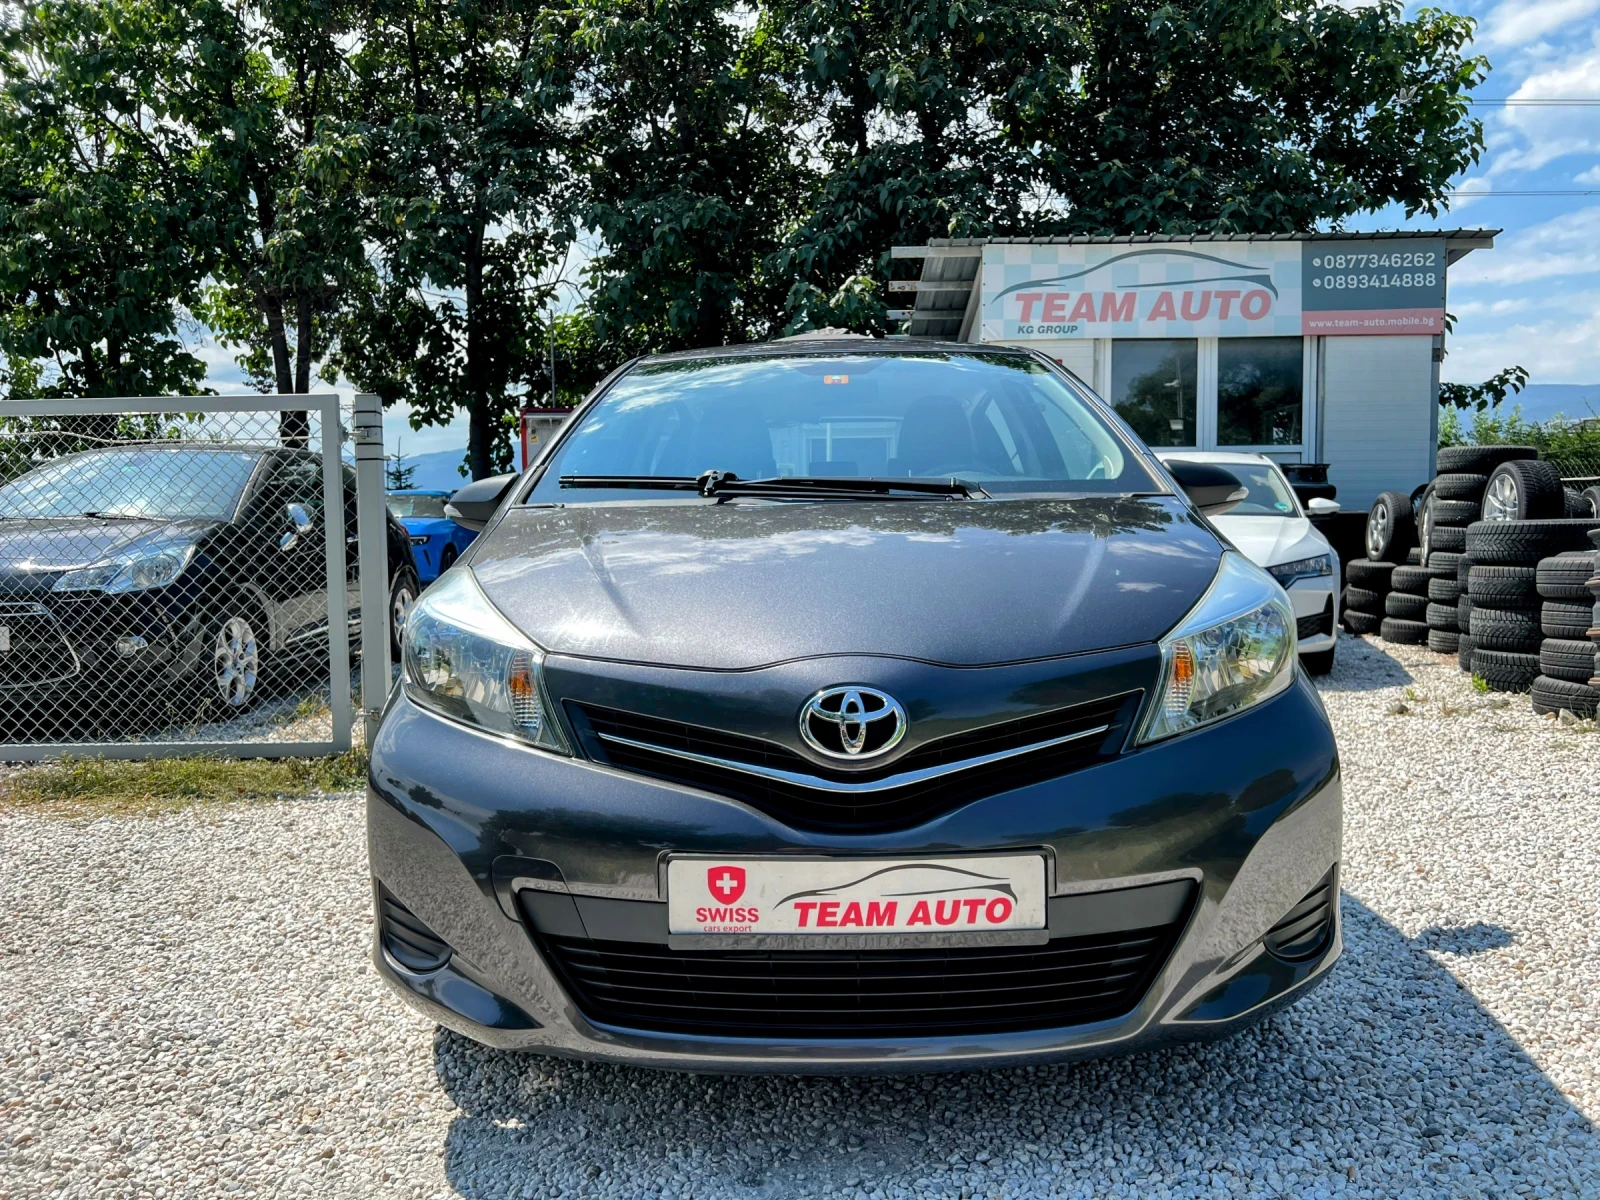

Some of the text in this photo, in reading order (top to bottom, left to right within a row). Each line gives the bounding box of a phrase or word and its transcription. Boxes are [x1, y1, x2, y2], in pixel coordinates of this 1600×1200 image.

[1323, 252, 1436, 269] 0877346262
[1323, 272, 1437, 289] 0893414888
[1015, 289, 1272, 323] TEAM AUTO
[1017, 325, 1078, 334] KG GROUP
[1308, 316, 1434, 328] www.team-auto.mobile.bg
[695, 907, 759, 923] SWISS
[793, 898, 1013, 927] TEAM AUTO
[703, 924, 752, 934] cars export
